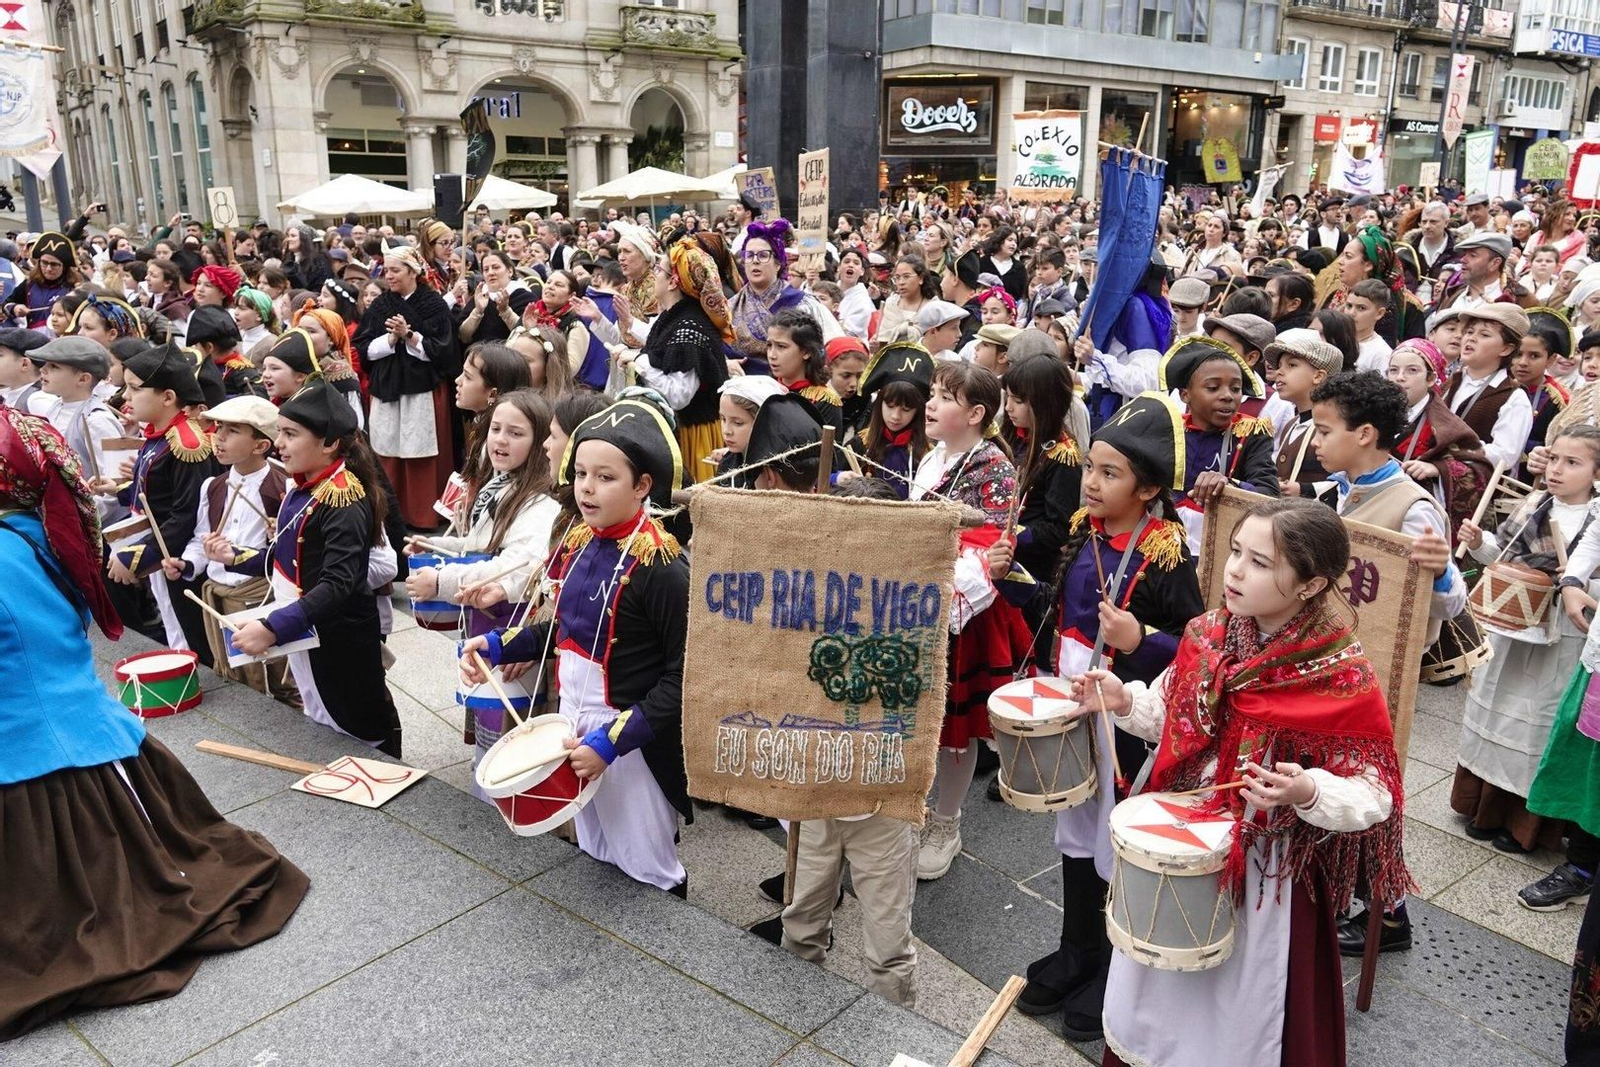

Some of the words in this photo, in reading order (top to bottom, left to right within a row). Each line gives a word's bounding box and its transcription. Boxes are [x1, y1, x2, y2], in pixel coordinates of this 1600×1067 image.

[1551, 31, 1584, 53] PSICA
[472, 92, 520, 118] ral
[1448, 93, 1461, 119] R
[1406, 121, 1416, 132] AS
[1416, 121, 1440, 134] Comput
[1019, 126, 1079, 158] COLEXIO
[804, 159, 824, 182] CEIP
[1013, 173, 1077, 189] ALBORADA
[897, 357, 922, 372] N
[591, 412, 636, 430] N
[706, 571, 765, 624] CEIP
[771, 569, 817, 632] RIA
[823, 570, 863, 635] DE
[871, 577, 942, 634] VIGO
[714, 726, 747, 777] EU
[752, 728, 809, 785] SON
[815, 730, 854, 784] DO
